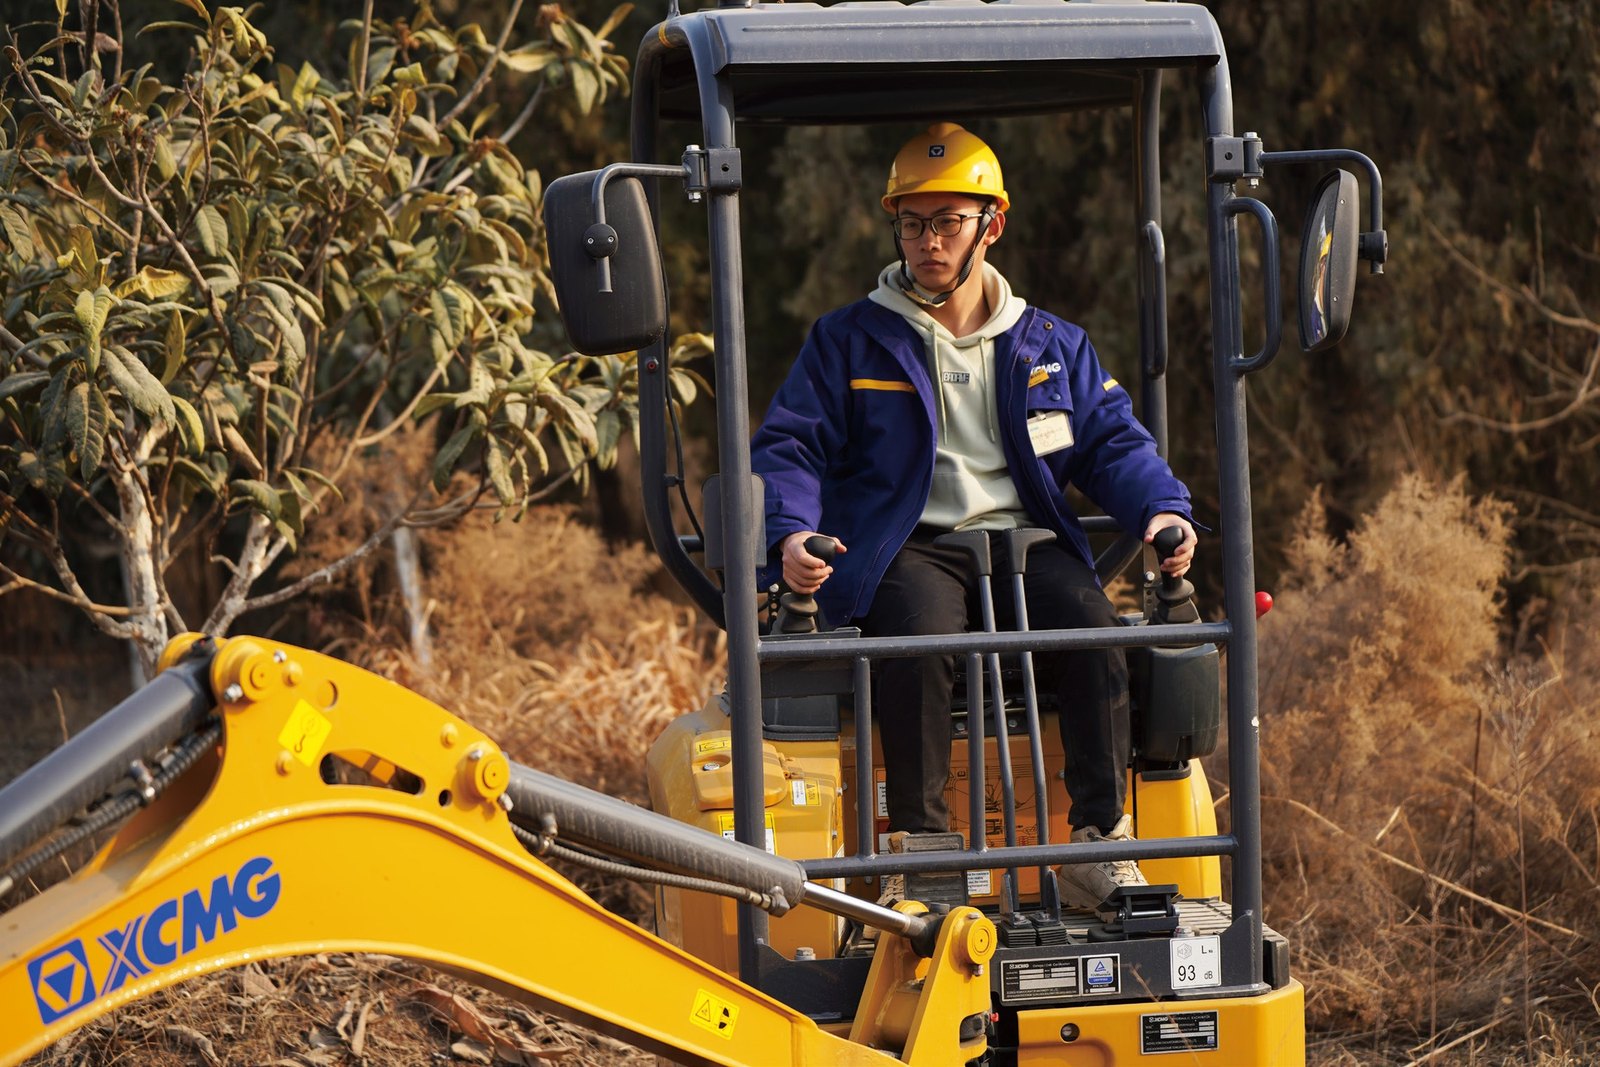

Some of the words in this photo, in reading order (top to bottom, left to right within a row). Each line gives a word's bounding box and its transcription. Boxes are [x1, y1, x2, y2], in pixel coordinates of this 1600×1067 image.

[97, 857, 281, 997] XCMG
[1178, 964, 1196, 982] 93
[1204, 970, 1213, 980] dB
